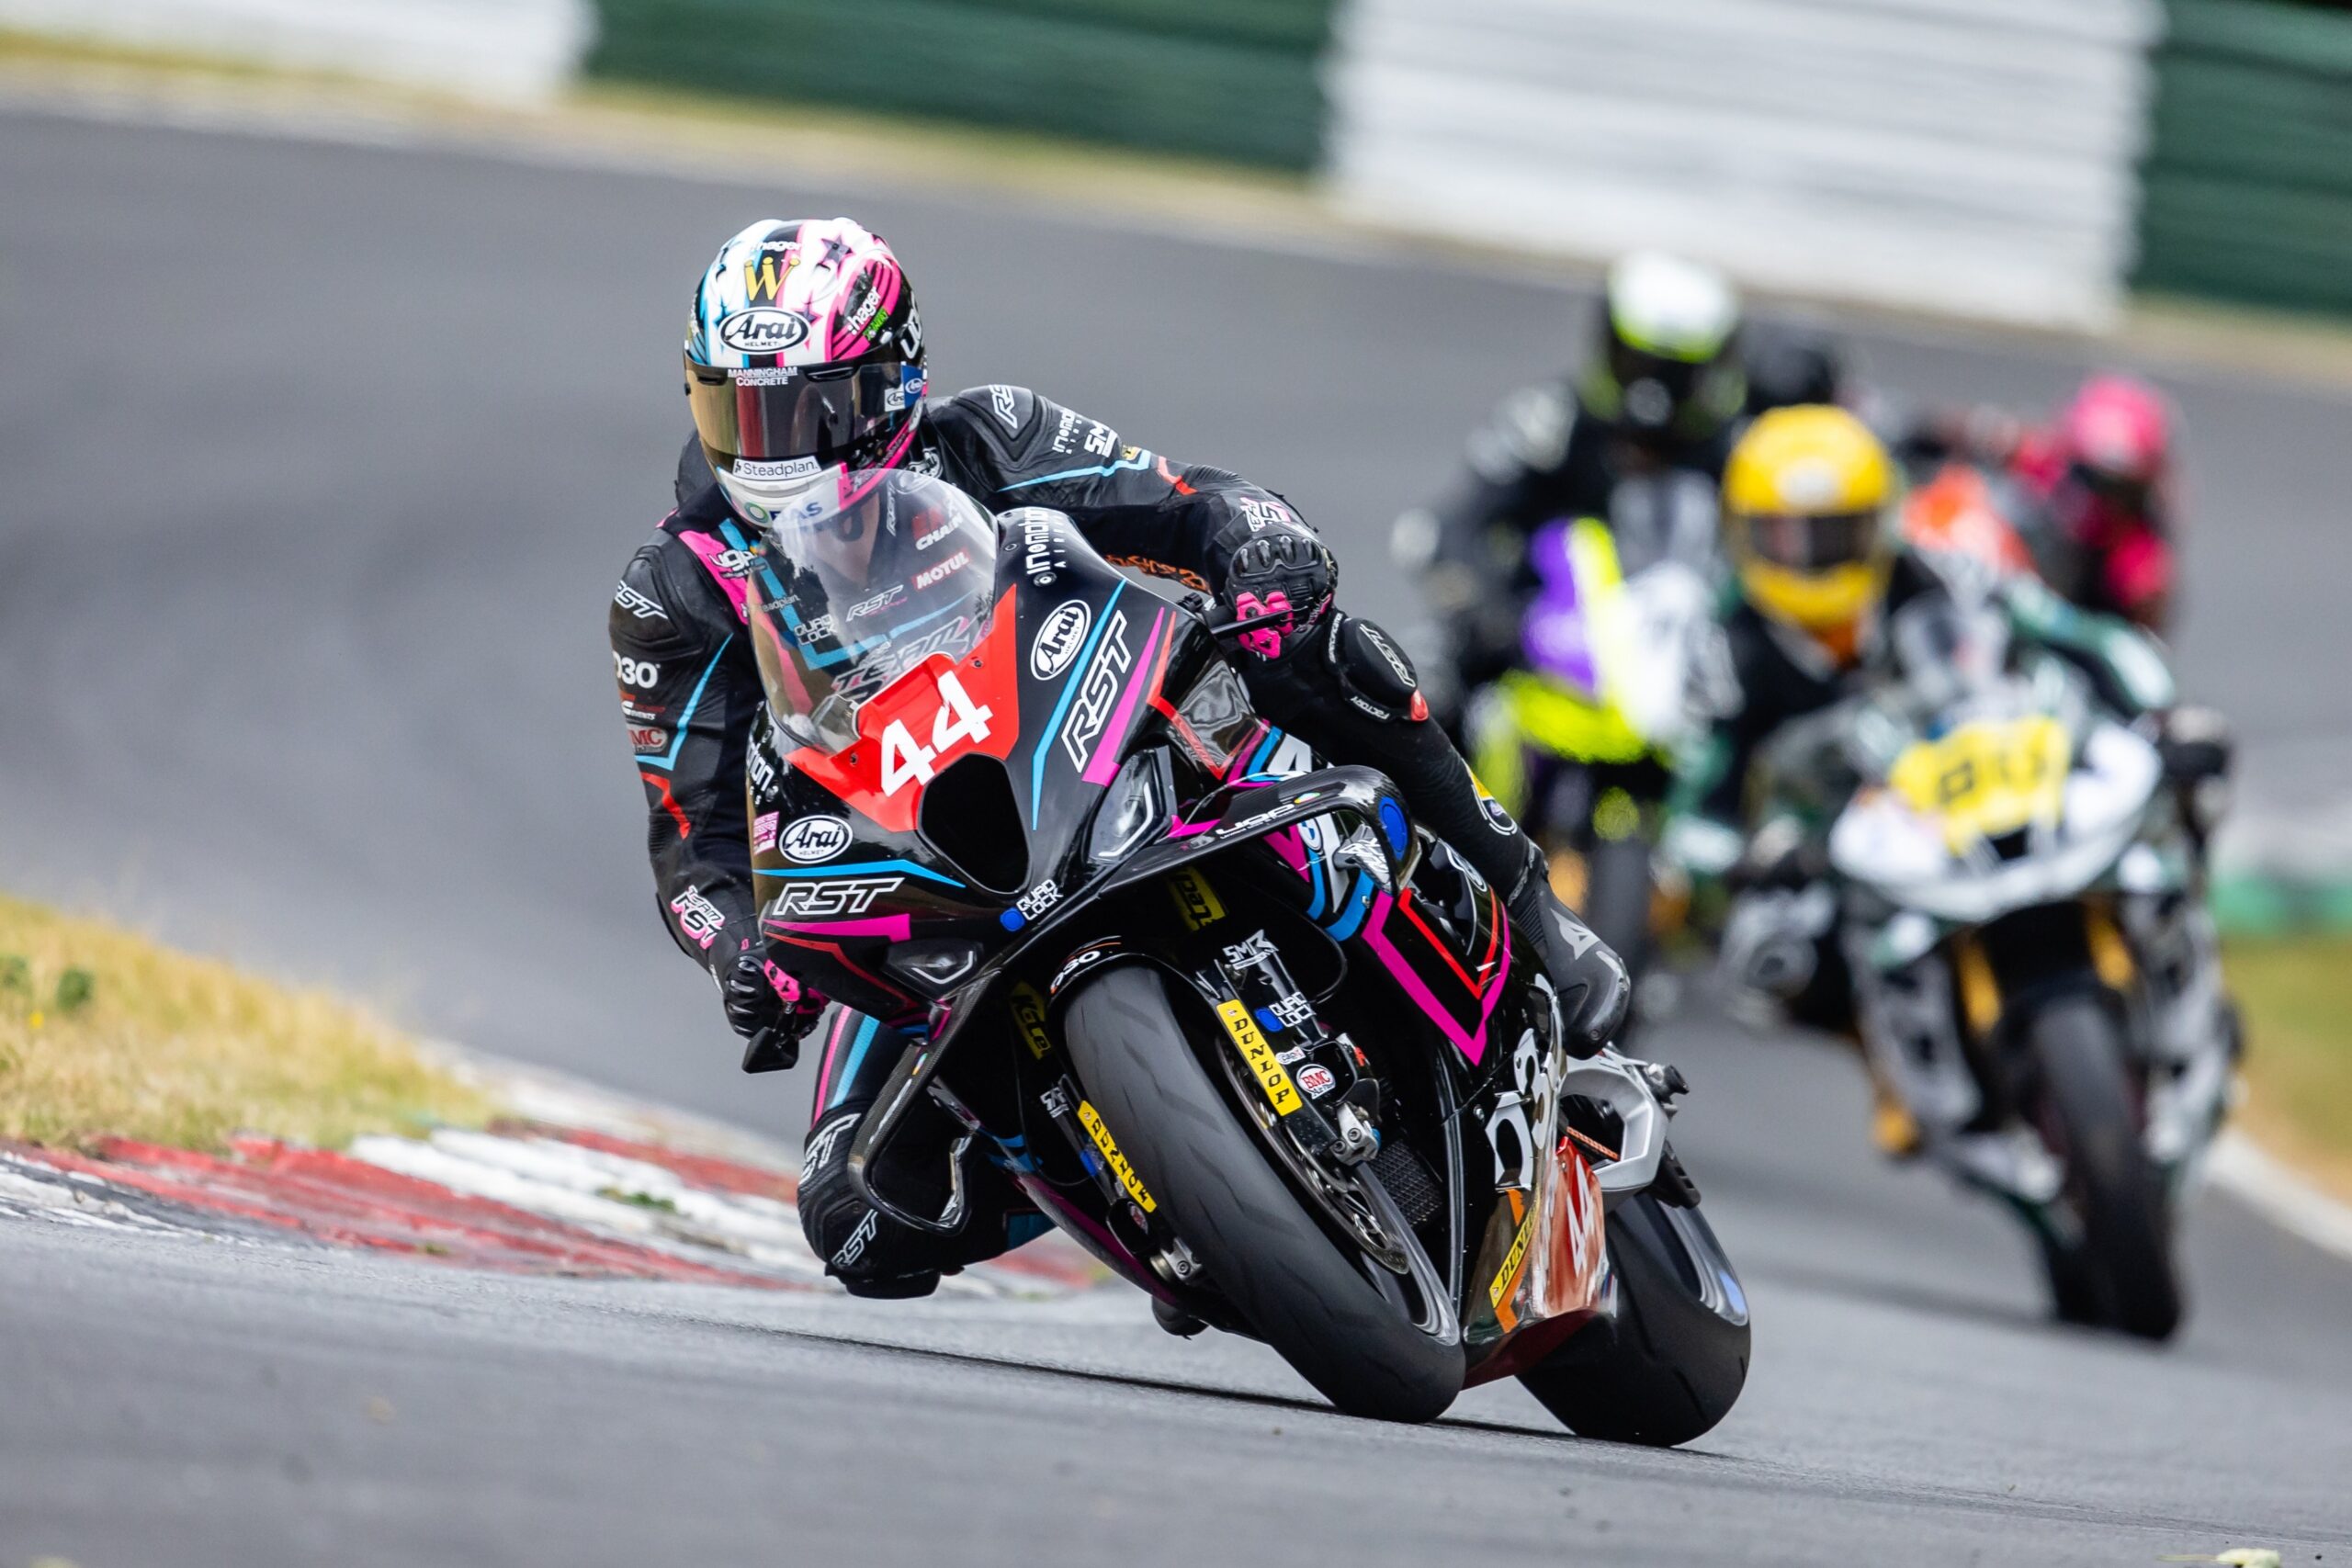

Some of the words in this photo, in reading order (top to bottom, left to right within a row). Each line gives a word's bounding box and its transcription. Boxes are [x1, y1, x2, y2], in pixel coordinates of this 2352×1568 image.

[724, 315, 797, 340] Arai
[727, 367, 798, 378] MANNINGHAM
[989, 384, 1018, 429] RS
[915, 552, 970, 590] MOTUL
[845, 584, 905, 622] RST
[794, 614, 834, 636] QUAD
[799, 624, 839, 646] LOCK
[1038, 608, 1080, 675] Arai
[1359, 623, 1416, 688] RST
[1061, 609, 1132, 773] RST
[630, 728, 663, 747] MC
[880, 671, 994, 797] 44
[783, 823, 842, 852] Arai
[772, 877, 906, 916] RST
[1015, 879, 1056, 911] QUAD
[1022, 888, 1065, 921] LOCK
[671, 891, 724, 951] RST
[1277, 1003, 1317, 1028] LOCK
[1233, 1017, 1291, 1106] DUNLOP
[1300, 1068, 1332, 1090] BMC
[1091, 1117, 1149, 1203] DUNLOP
[831, 1208, 878, 1268] RST
